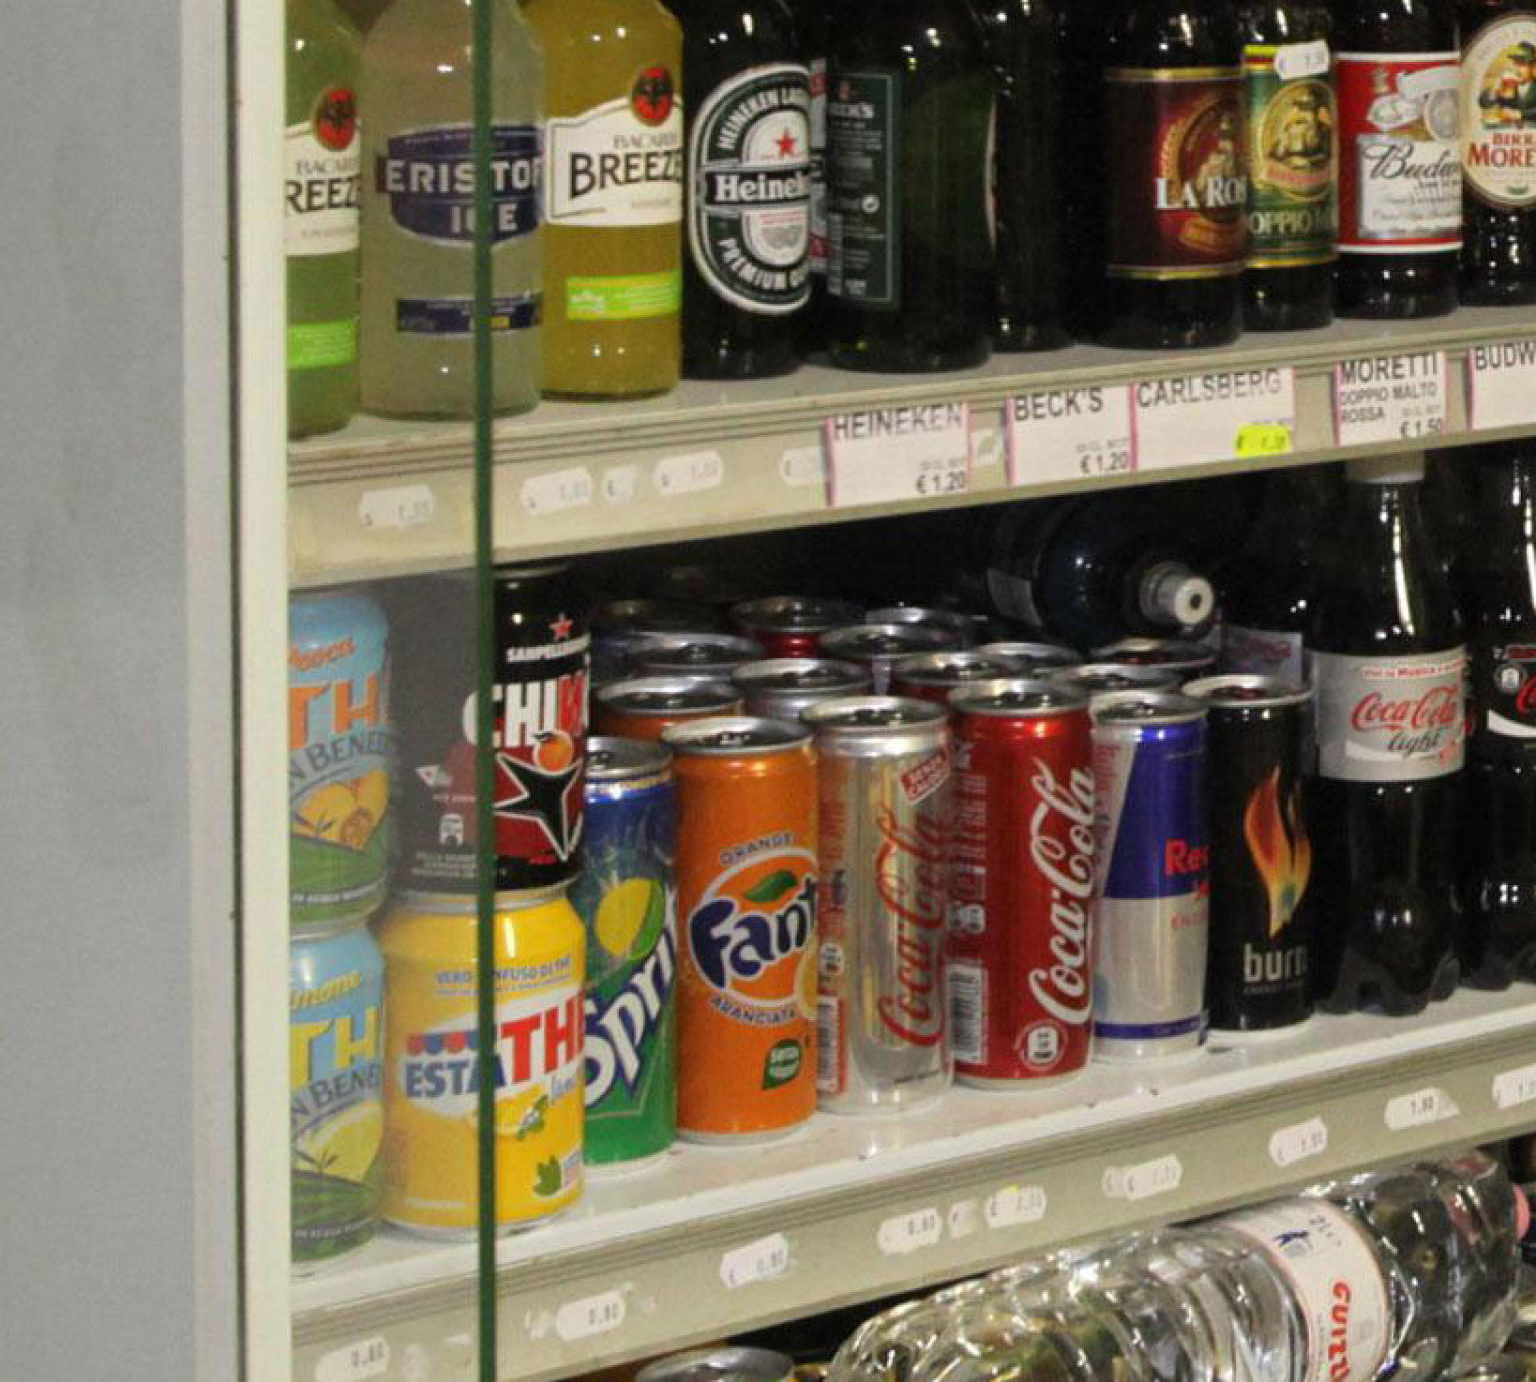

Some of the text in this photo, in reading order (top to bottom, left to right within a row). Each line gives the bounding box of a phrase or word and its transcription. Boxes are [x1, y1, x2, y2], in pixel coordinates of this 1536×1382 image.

[1340, 351, 1439, 385] MORETTI
[1013, 387, 1105, 422] BECK'S
[1138, 368, 1284, 409] CARLSBERG
[833, 403, 964, 440] HEINEKEN
